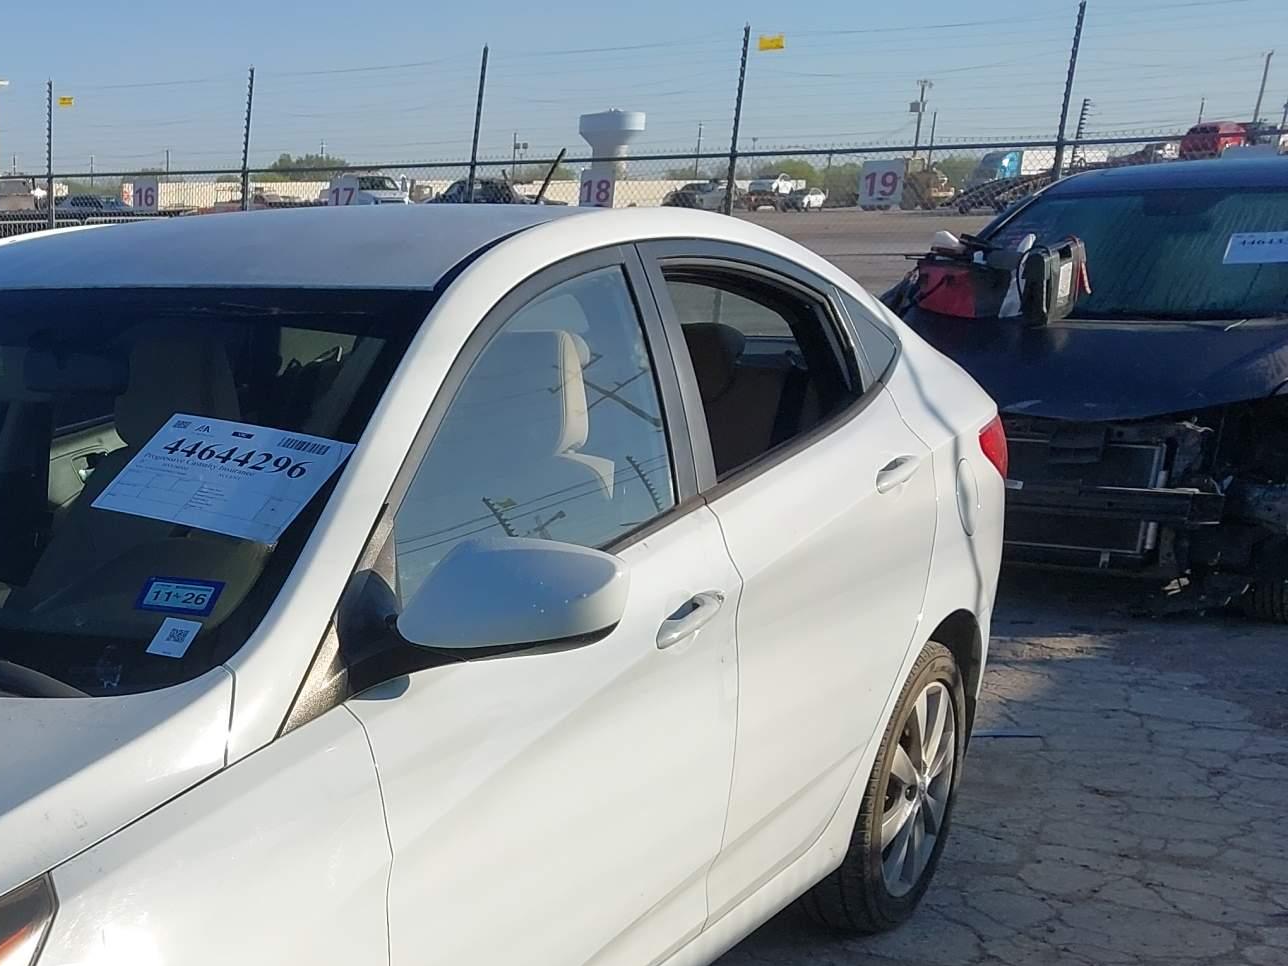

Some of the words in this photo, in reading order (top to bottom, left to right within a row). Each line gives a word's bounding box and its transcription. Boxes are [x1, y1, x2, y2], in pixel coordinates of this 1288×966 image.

[583, 179, 611, 203] 18
[865, 171, 898, 197] 19
[135, 187, 155, 207] 16
[332, 187, 355, 206] 17
[163, 438, 313, 479] 44644296
[152, 590, 173, 602] 11
[182, 592, 207, 605] 26
